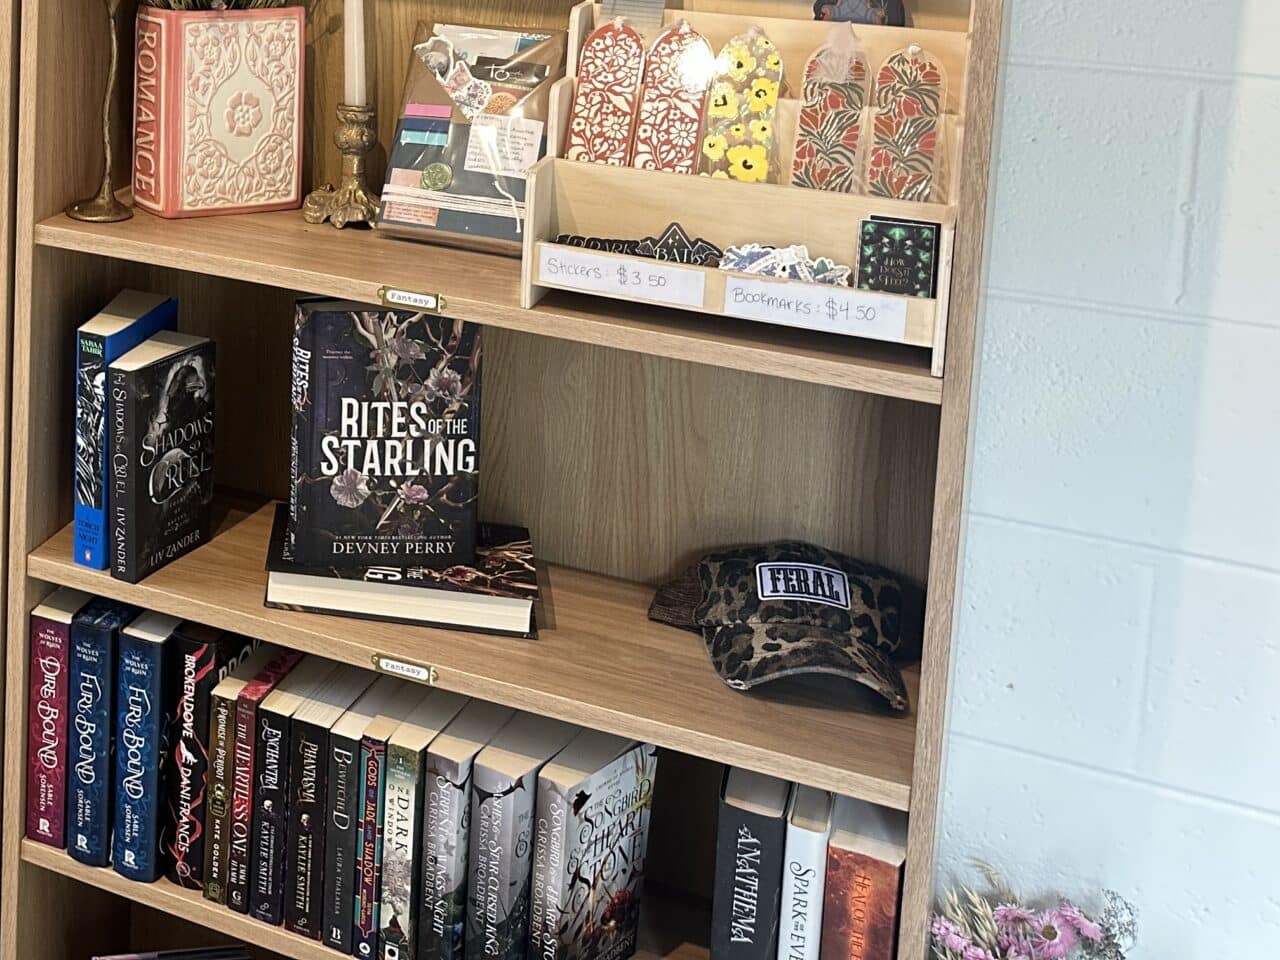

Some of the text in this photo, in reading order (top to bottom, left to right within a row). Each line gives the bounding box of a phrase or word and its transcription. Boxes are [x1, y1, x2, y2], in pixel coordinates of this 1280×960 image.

[133, 29, 156, 198] ROMANCE
[341, 397, 468, 439] RITES OF THE
[321, 436, 476, 477] STARLING
[114, 507, 126, 573] LIV ZANDER
[332, 541, 456, 555] DEVNEY PERRY
[768, 567, 841, 602] FERAL
[37, 655, 61, 770] DIRE BOUND
[182, 654, 196, 739] BROKEN DOVE
[259, 718, 281, 795] ENCHANTRA
[298, 736, 318, 805] PHANTASMA
[332, 746, 353, 831] BEWITCHED
[367, 760, 378, 787] GODS
[179, 766, 192, 854] DANI FRANCIS
[395, 795, 409, 852] DARK
[258, 860, 268, 894] SMITH
[362, 841, 374, 884] SHADOW
[424, 792, 438, 910] CARISSA BROADBENT
[730, 824, 761, 944] ANATHEMA
[789, 861, 816, 920] SPARK
